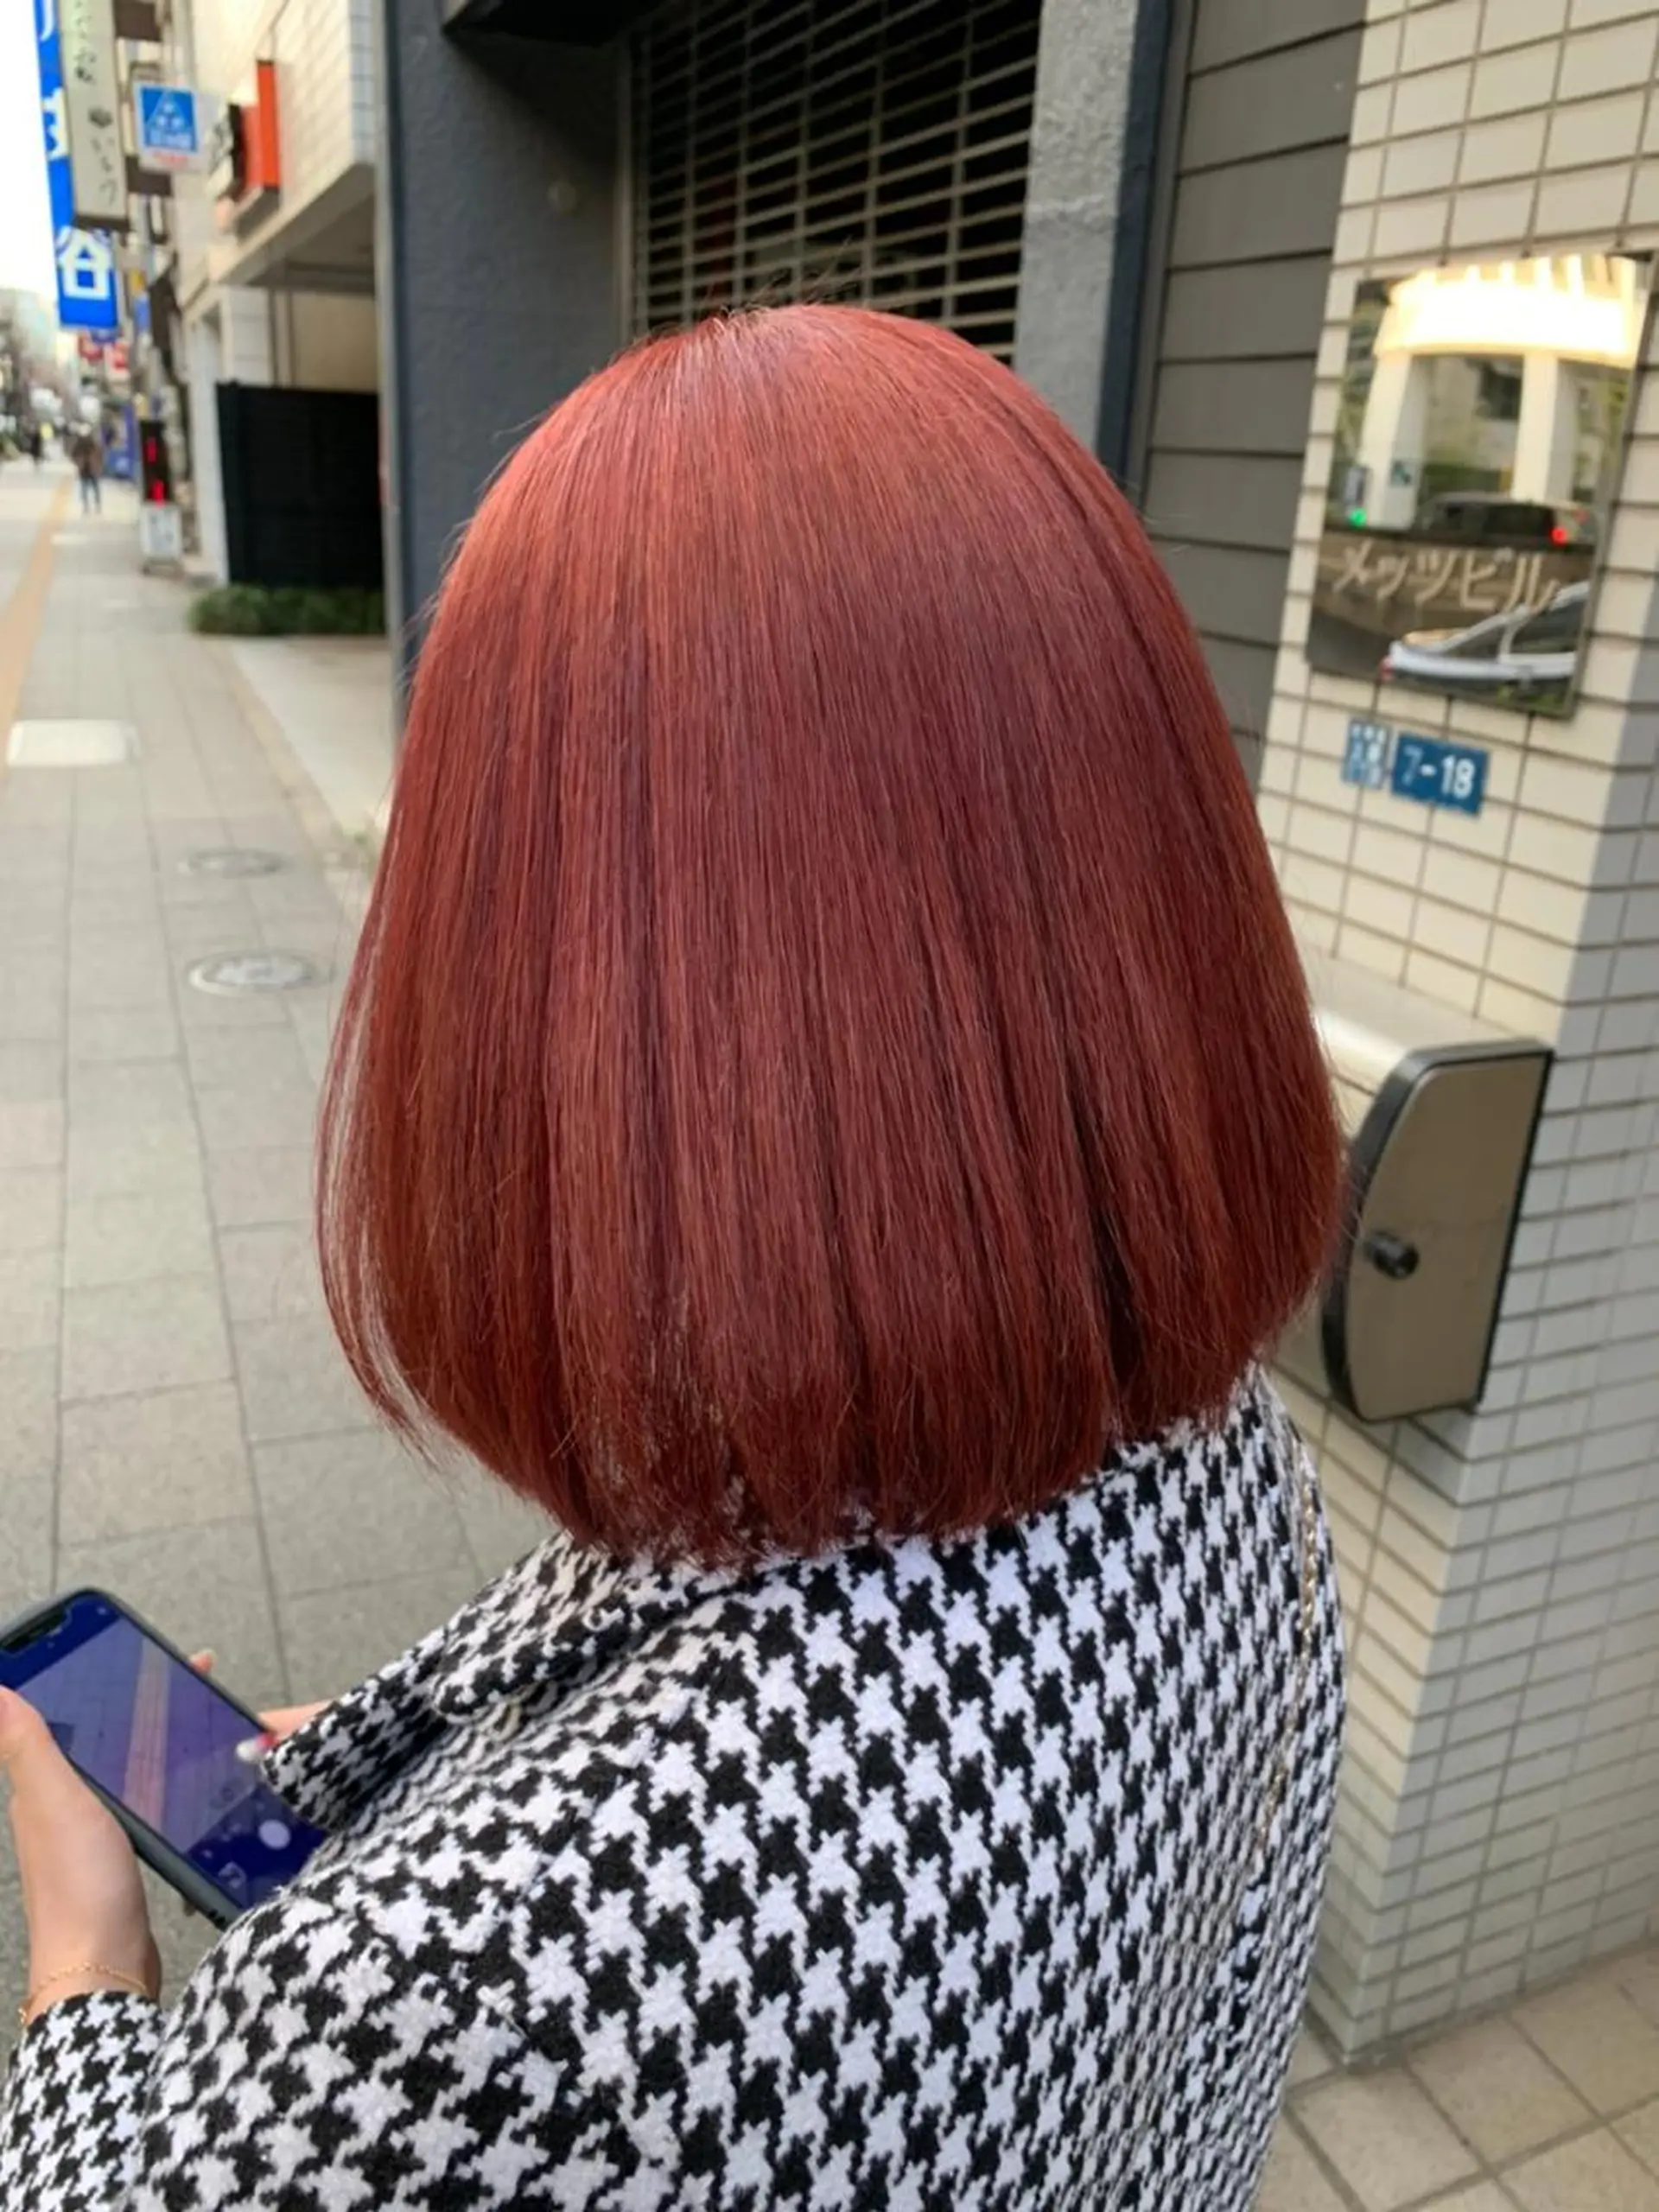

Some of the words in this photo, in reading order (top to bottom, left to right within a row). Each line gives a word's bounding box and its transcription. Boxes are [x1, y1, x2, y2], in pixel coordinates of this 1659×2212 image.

[1332, 537, 1559, 613] メッツビル
[1401, 744, 1476, 799] 7-18
